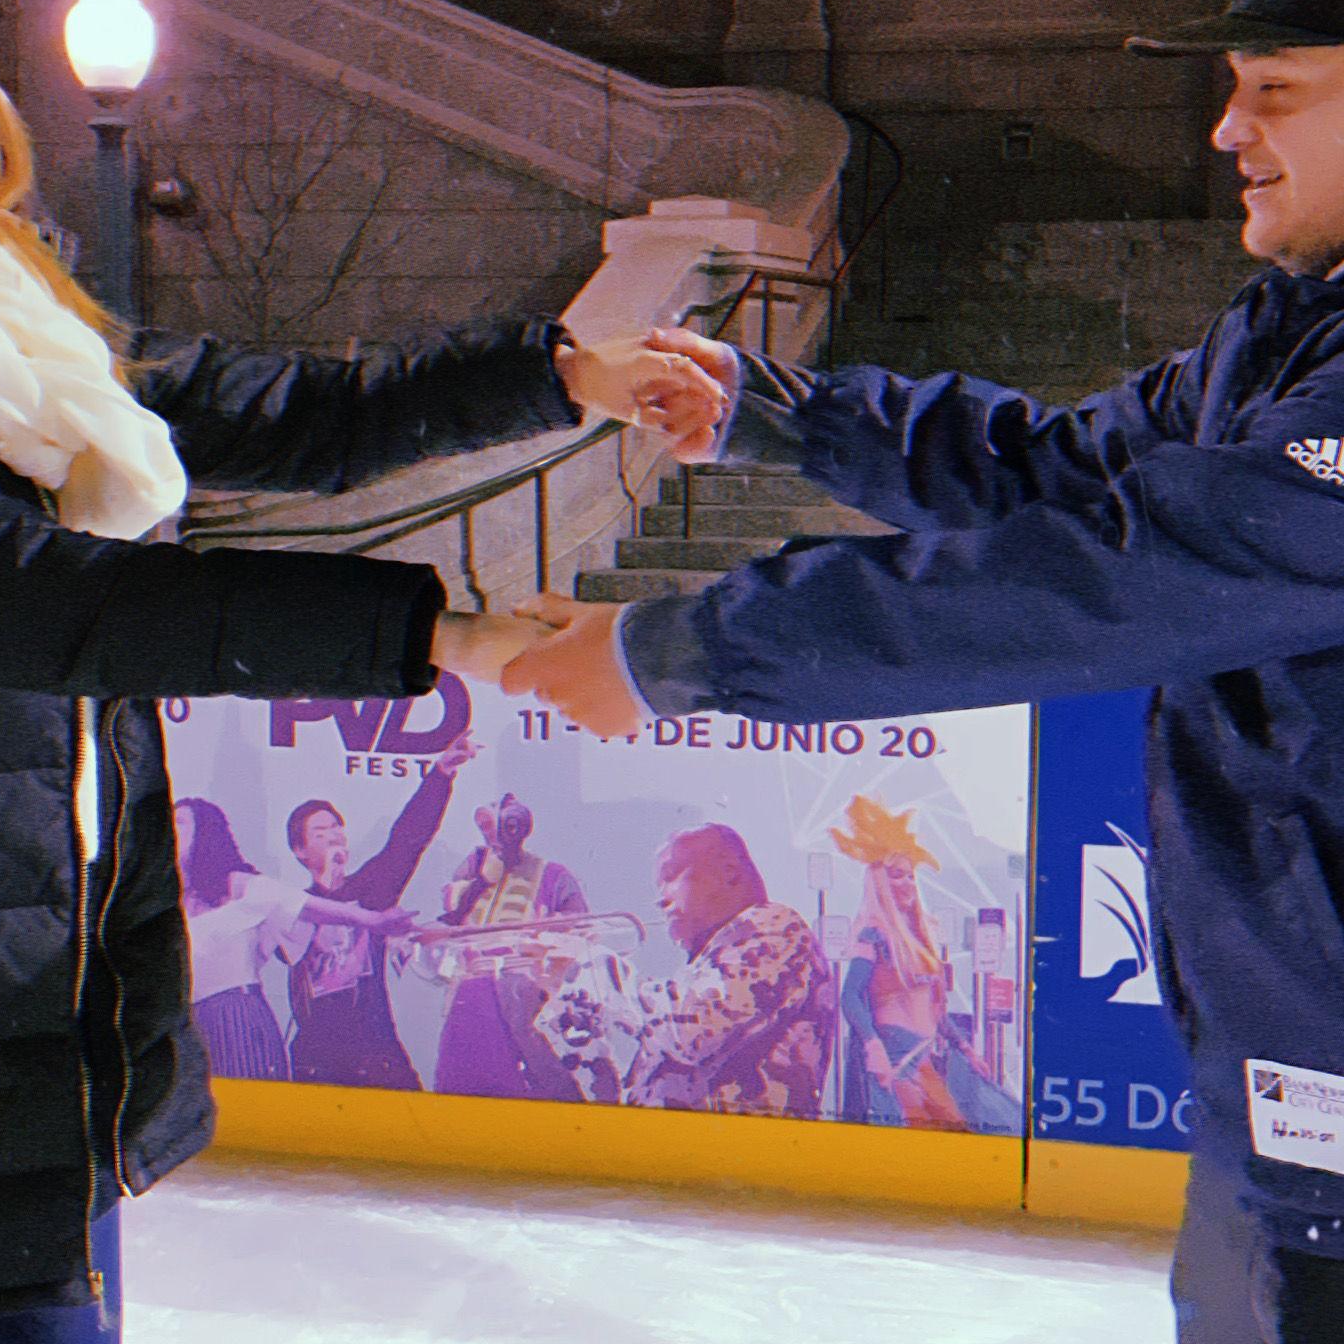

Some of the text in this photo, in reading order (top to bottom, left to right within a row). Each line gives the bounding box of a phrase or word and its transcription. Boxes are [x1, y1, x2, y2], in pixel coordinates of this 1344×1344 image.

[518, 709, 550, 740] 11
[656, 717, 712, 749] DE
[726, 719, 863, 755] JUNIO
[346, 756, 432, 778] FEST
[1041, 1076, 1106, 1127] 55
